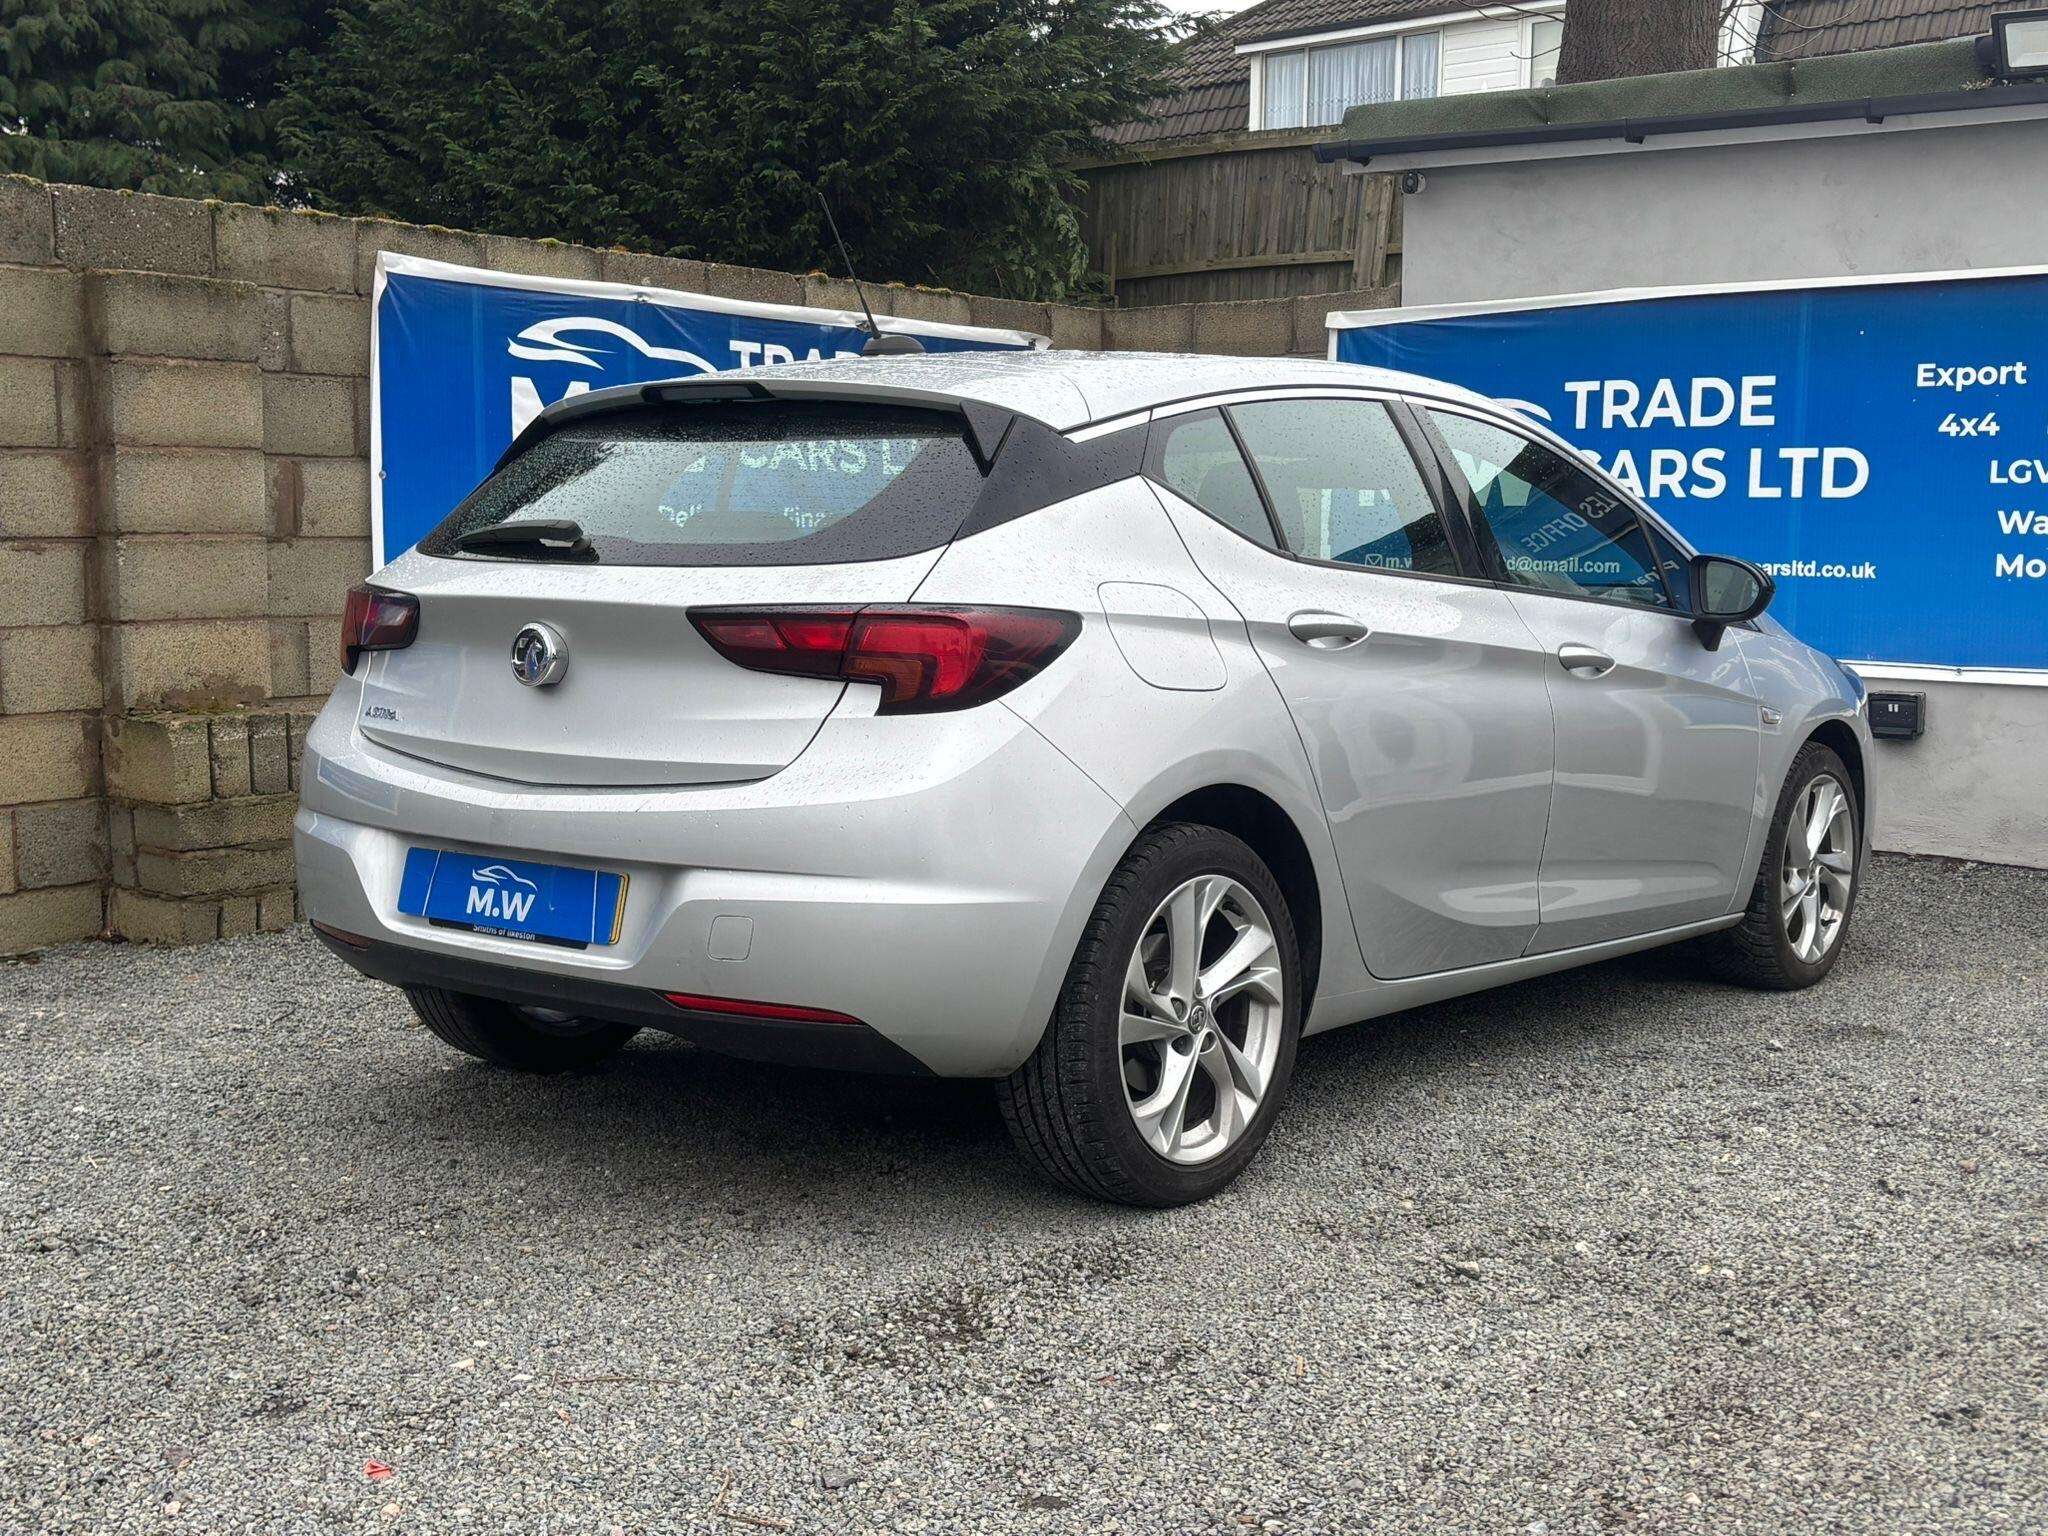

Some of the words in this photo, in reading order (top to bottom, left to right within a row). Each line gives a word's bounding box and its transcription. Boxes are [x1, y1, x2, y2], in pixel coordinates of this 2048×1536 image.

[1916, 361, 2027, 392] Export
[1565, 376, 1776, 429] TRADE
[1938, 412, 2001, 437] 4x4
[1748, 447, 1870, 499] LTD
[1995, 553, 2048, 578] Mo
[466, 885, 536, 922] M.W
